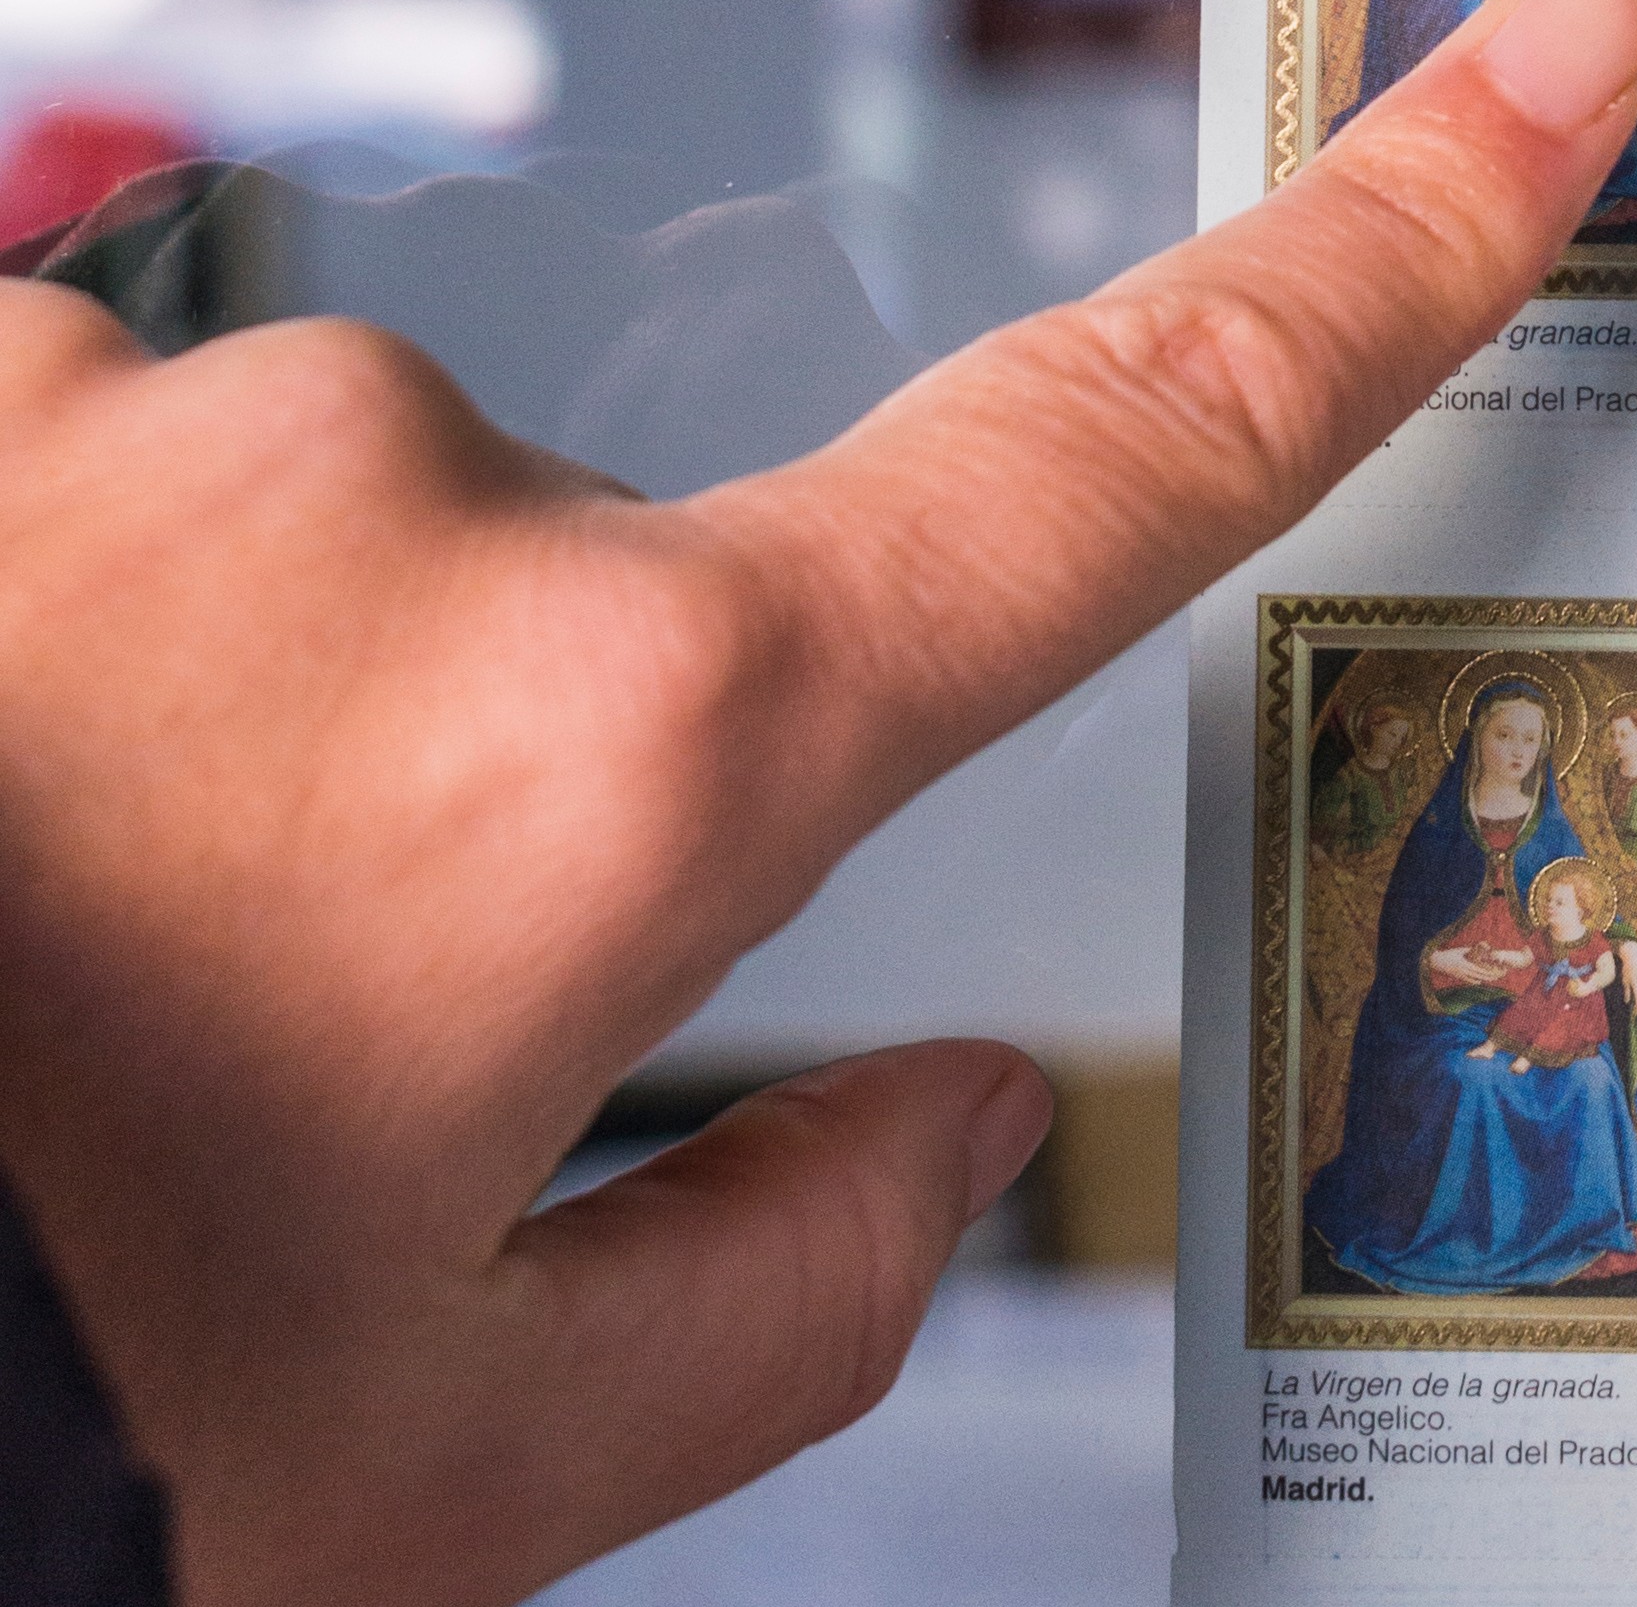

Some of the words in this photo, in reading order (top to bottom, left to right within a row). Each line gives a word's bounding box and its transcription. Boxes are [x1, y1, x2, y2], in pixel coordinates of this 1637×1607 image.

[1507, 319, 1637, 350] granada.
[1420, 384, 1511, 412] cional
[1521, 384, 1564, 411] del
[1263, 1369, 1299, 1398] La
[1312, 1369, 1402, 1401] Virgen
[1411, 1370, 1449, 1397] de
[1457, 1371, 1482, 1397] la
[1490, 1373, 1621, 1404] granada.
[1261, 1402, 1308, 1429] Fra
[1317, 1403, 1453, 1435] Angelico.
